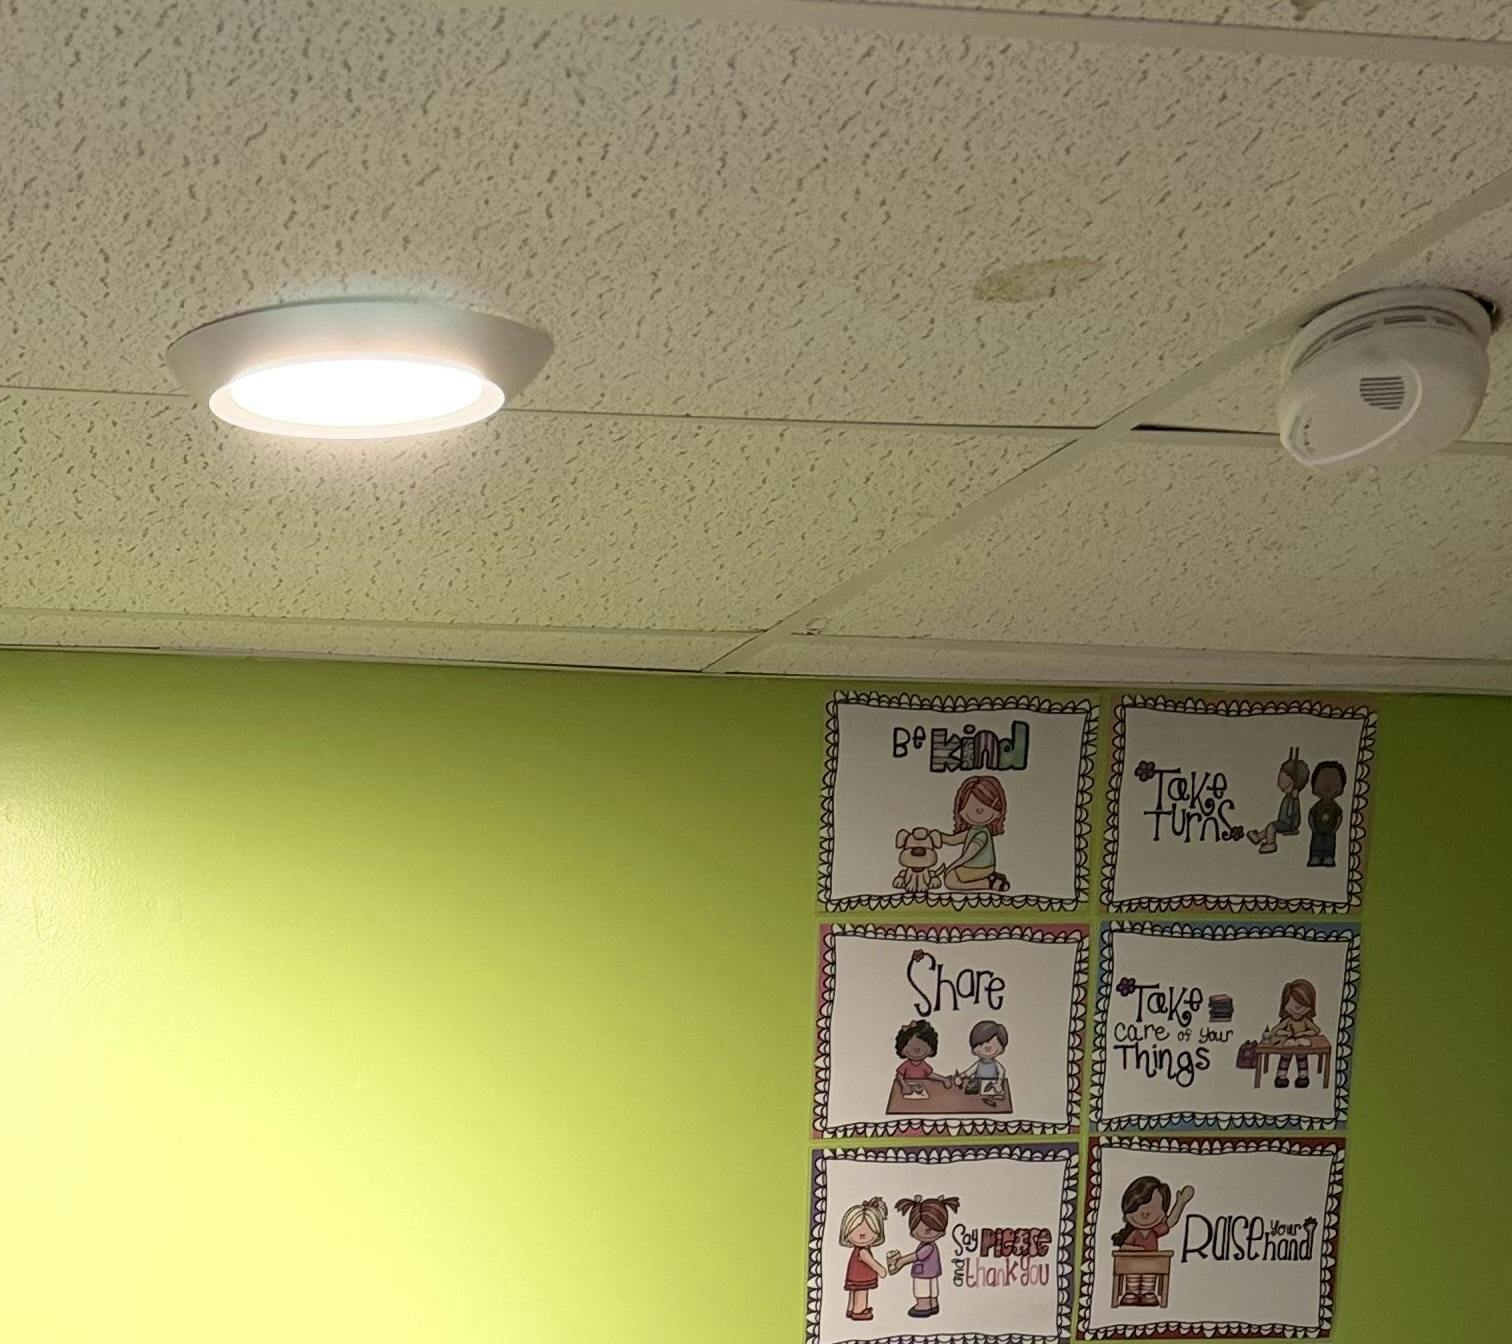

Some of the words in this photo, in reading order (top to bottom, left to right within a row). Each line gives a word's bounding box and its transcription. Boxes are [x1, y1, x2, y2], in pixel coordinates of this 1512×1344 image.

[893, 725, 926, 757] Be
[930, 720, 1030, 772] kind
[1148, 767, 1228, 816] Take
[906, 951, 1006, 1017] Share
[1130, 983, 1204, 1027] Take
[1114, 1022, 1170, 1042] care
[1178, 1029, 1192, 1042] of
[1113, 1042, 1210, 1088] Things
[952, 1223, 978, 1256] Say
[1263, 1228, 1316, 1261] hand
[951, 1258, 965, 1287] and
[966, 1257, 1019, 1288] thank
